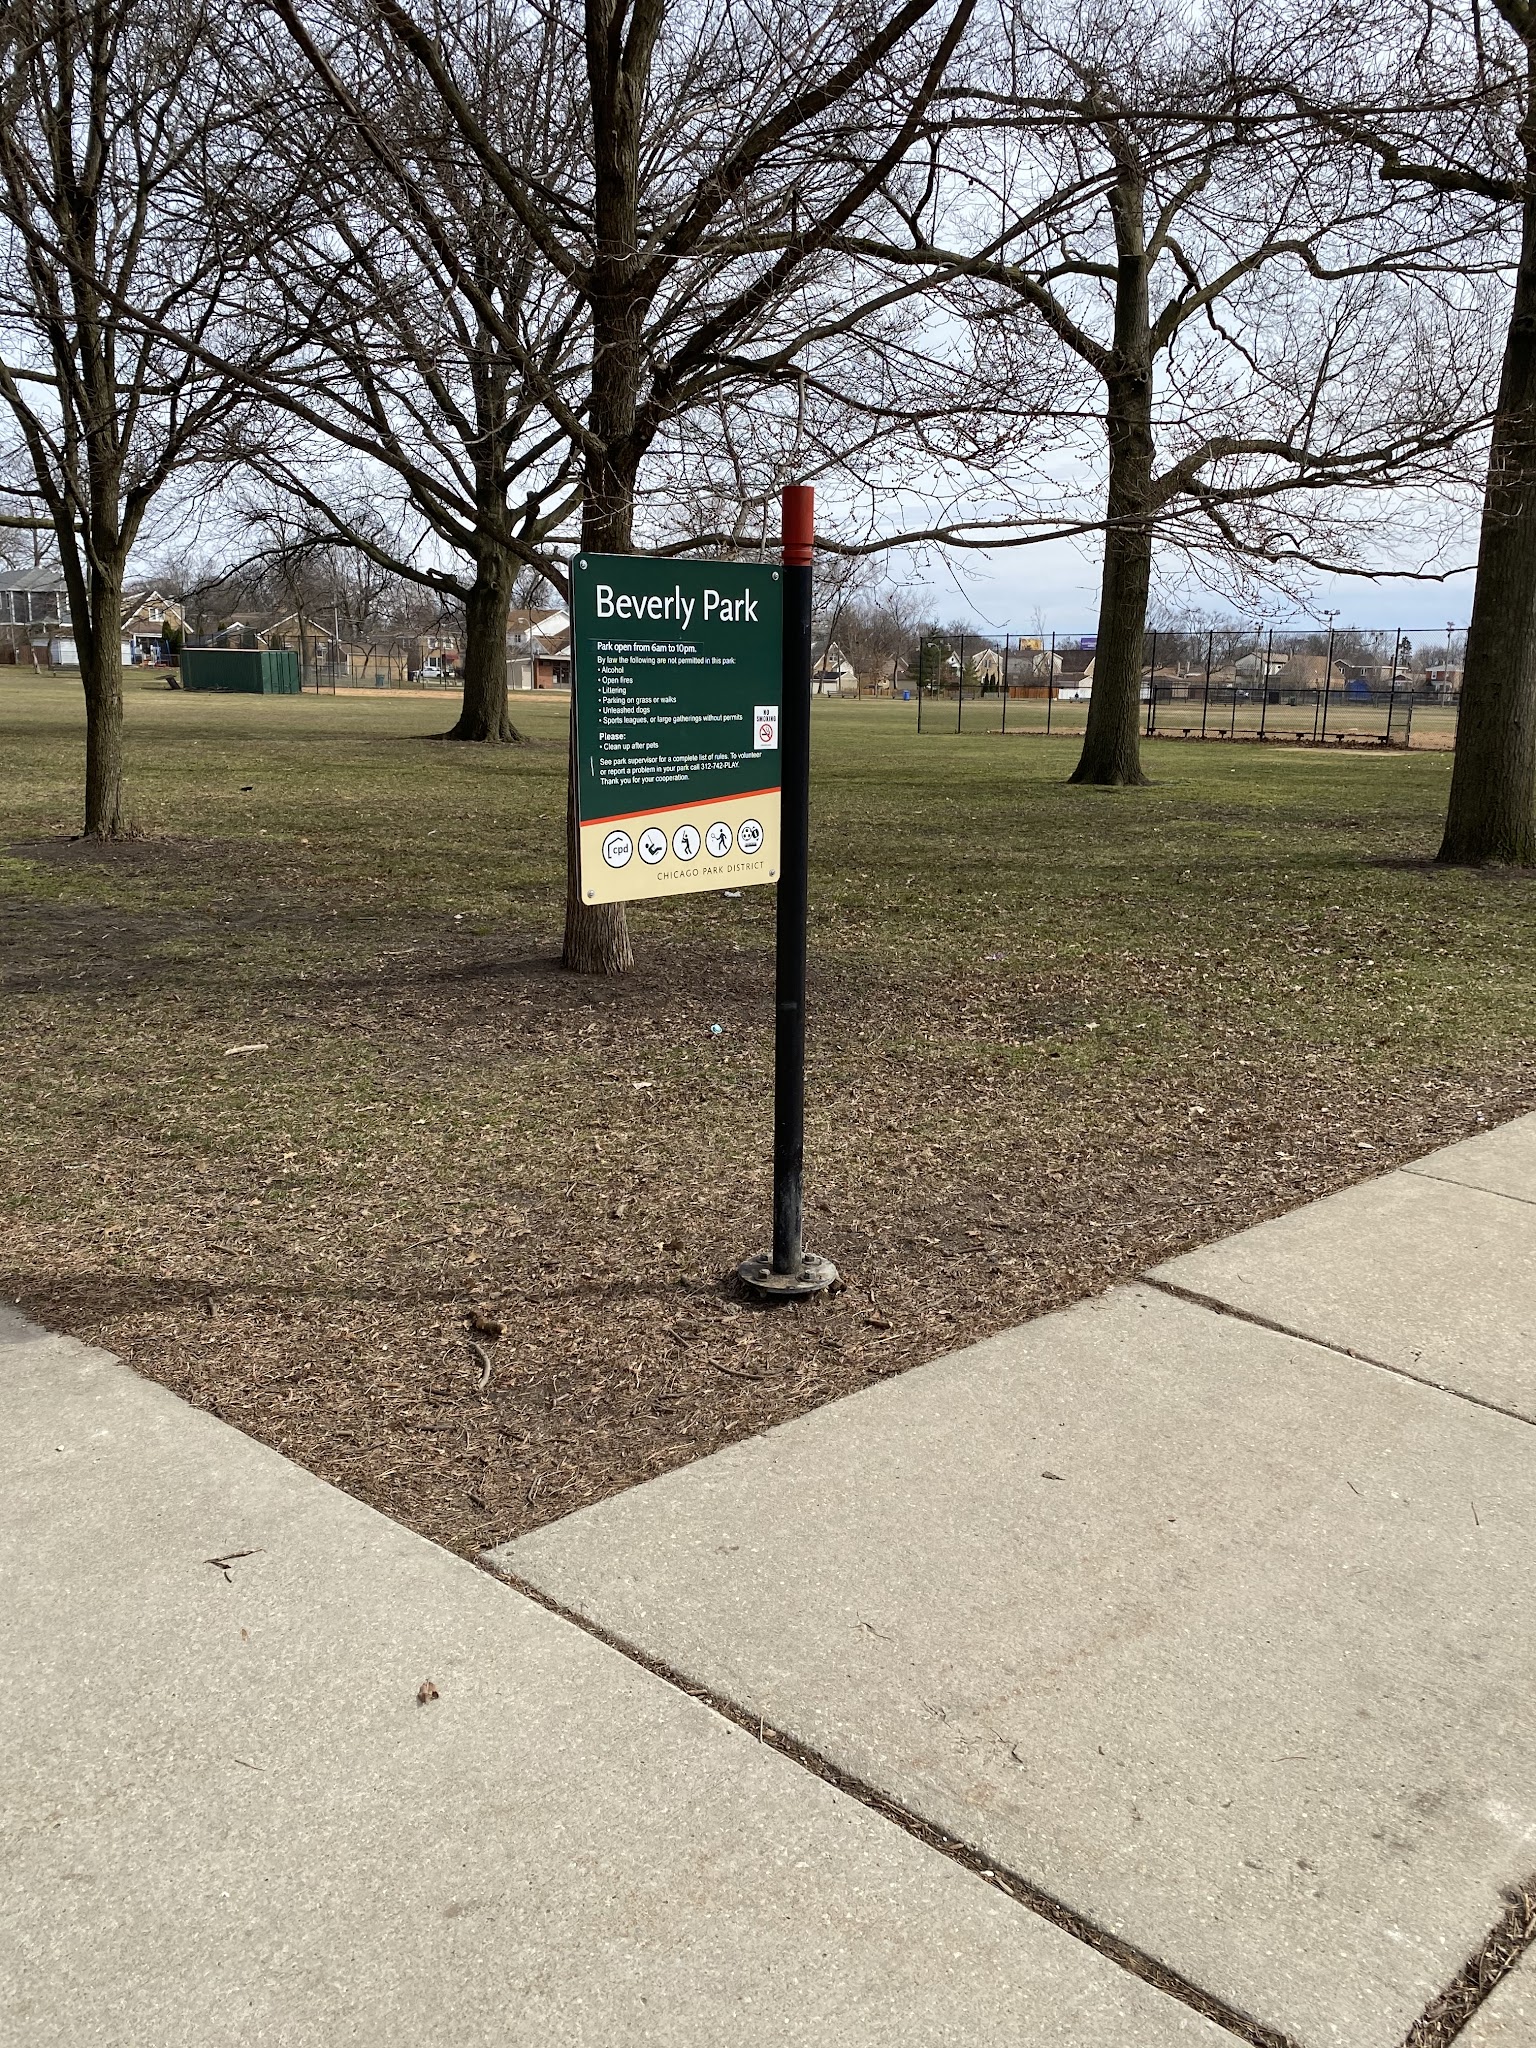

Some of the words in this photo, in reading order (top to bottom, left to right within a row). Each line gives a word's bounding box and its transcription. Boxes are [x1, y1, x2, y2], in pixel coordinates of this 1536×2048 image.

[596, 584, 696, 631] Beverly
[703, 588, 759, 622] Park
[597, 641, 613, 651] Park
[613, 643, 632, 653] open
[633, 642, 650, 652] from
[651, 643, 667, 652] 6am
[668, 644, 675, 653] to
[676, 644, 697, 655] 10pm.
[597, 656, 606, 665] By
[606, 656, 618, 664] law
[619, 656, 629, 664] the
[629, 656, 655, 665] following
[677, 657, 704, 665] permitted
[601, 666, 624, 674] Alcohol
[601, 676, 619, 685] Open
[620, 676, 634, 684] fires
[602, 686, 627, 695] Littering
[602, 696, 626, 705] Parking
[635, 697, 652, 705] grass
[602, 706, 635, 714] Unleashed
[635, 706, 651, 715] dogs
[602, 716, 623, 725] Sports
[623, 716, 649, 725] leagues,
[657, 715, 672, 724] large
[672, 714, 702, 724] gatherings
[703, 714, 722, 722] without
[723, 714, 743, 722] permits
[599, 732, 627, 741] Please:
[603, 743, 622, 751] Clean
[622, 743, 630, 751] up
[631, 742, 645, 750] after
[645, 742, 659, 750] pets
[600, 758, 612, 766] See
[613, 757, 627, 766] park
[627, 756, 658, 765] supervisor
[658, 755, 667, 763] for
[672, 754, 698, 763] complete
[737, 751, 763, 759] volunteer
[607, 768, 626, 776] report
[631, 766, 655, 775] problem
[662, 765, 676, 773] your
[676, 764, 690, 773] park
[690, 763, 700, 771] call
[600, 777, 620, 785] Thank
[620, 778, 632, 786] you
[632, 776, 641, 784] for
[641, 776, 655, 784] your
[612, 844, 629, 855] cpd
[657, 868, 699, 881] CHICAGO
[702, 866, 724, 875] PARK
[727, 861, 764, 873] DISTRICT
